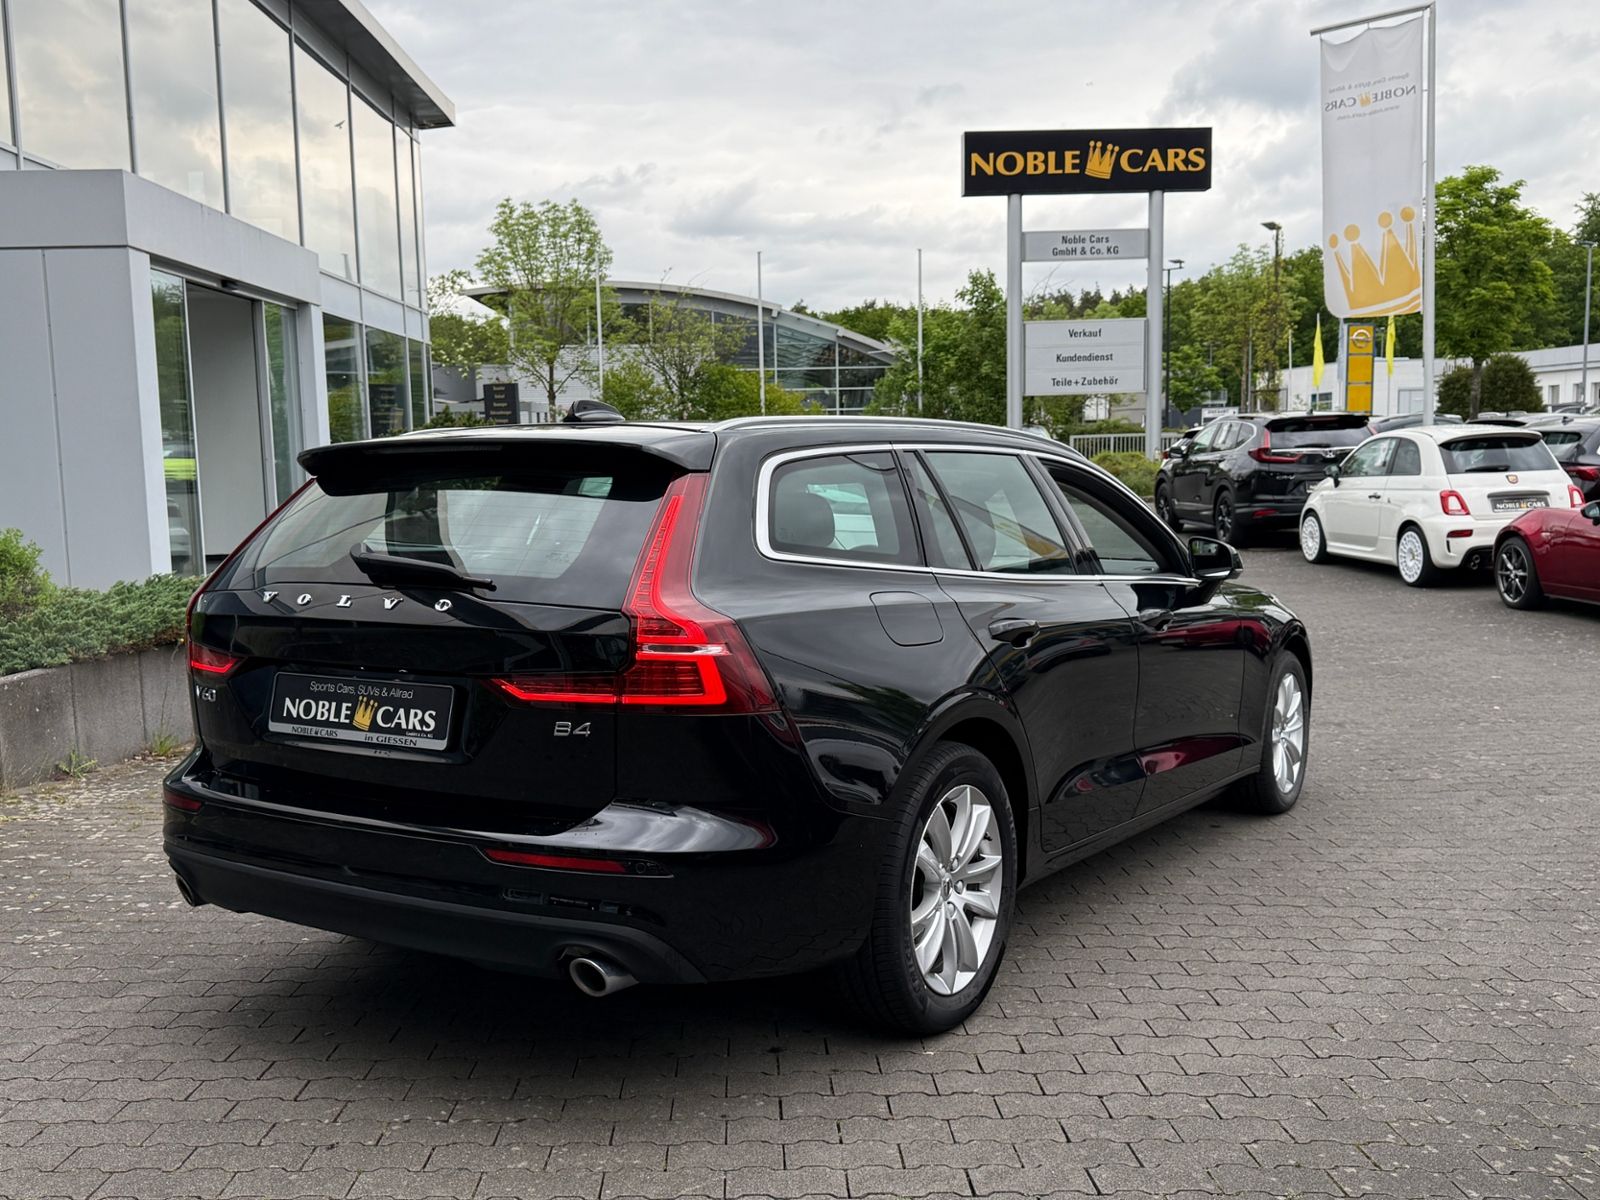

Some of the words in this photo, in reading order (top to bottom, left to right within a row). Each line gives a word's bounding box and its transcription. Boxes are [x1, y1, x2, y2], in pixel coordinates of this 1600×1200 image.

[970, 150, 1081, 177] NOBLE
[1119, 147, 1206, 173] CARS
[1061, 235, 1087, 244] Noble
[1089, 234, 1110, 244] Cars
[1052, 247, 1077, 256] GmbH
[1080, 246, 1087, 255] &
[1089, 246, 1104, 255] Co.
[1106, 245, 1119, 255] KG
[1068, 328, 1102, 338] Verkauf
[1056, 353, 1114, 363] Kundendienst
[263, 591, 453, 612] VOLVO
[310, 681, 335, 693] Sports
[336, 683, 356, 695] Cars,
[357, 685, 380, 697] SUVs
[381, 687, 388, 697] &
[389, 688, 414, 699] Allrad
[283, 697, 352, 724] NOBLE
[376, 706, 436, 732] CARS
[291, 725, 315, 736] NOBLE
[319, 728, 338, 738] CARS
[553, 721, 591, 737] B4
[364, 734, 373, 742] in
[376, 736, 418, 747] GIESSEN
